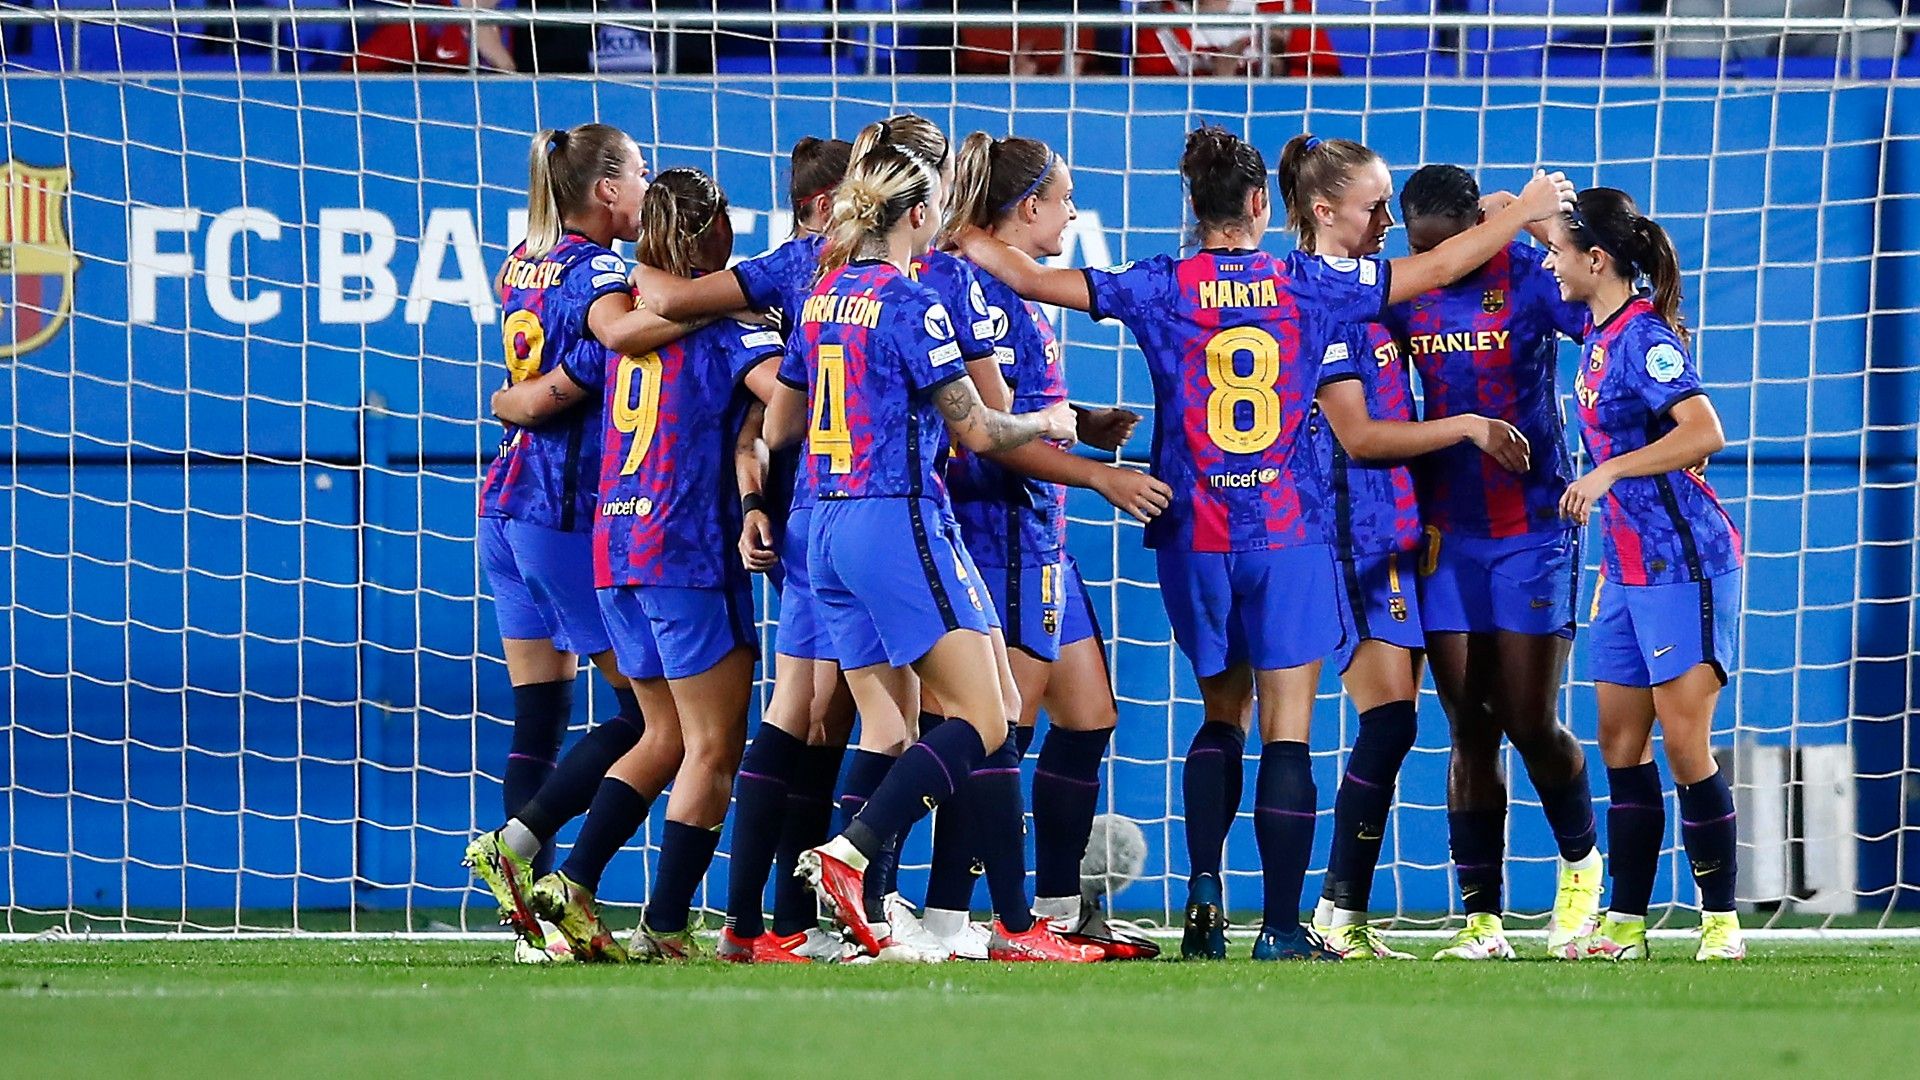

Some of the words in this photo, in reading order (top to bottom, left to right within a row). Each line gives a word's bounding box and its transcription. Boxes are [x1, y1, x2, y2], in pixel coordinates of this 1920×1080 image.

[130, 207, 282, 325] FC
[1199, 279, 1278, 309] MARTA
[835, 287, 884, 329] LEÓN
[1410, 330, 1510, 356] STANLEY
[612, 351, 664, 476] 9
[809, 344, 854, 474] 4
[1204, 325, 1282, 454] 8
[602, 496, 637, 516] unicef
